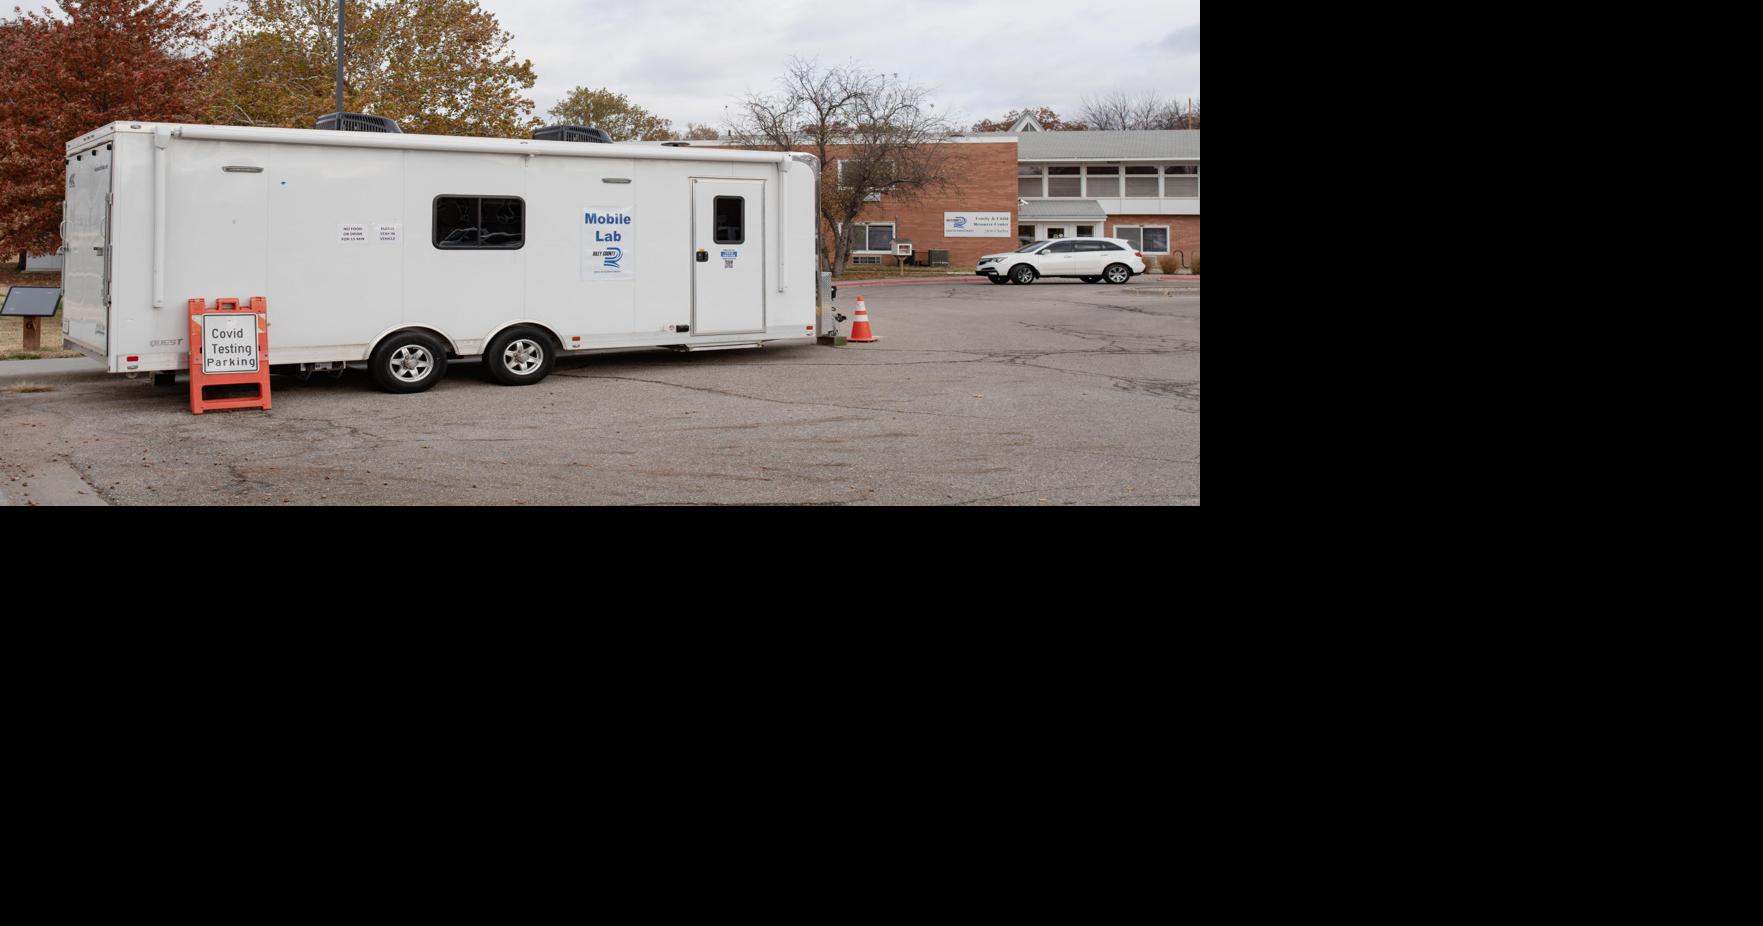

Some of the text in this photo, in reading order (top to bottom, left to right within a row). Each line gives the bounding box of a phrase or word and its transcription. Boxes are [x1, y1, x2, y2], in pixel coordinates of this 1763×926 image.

[584, 212, 631, 224] Mobile
[595, 230, 622, 242] Lab
[211, 328, 244, 339] Covid
[212, 343, 252, 356] Testing
[207, 357, 256, 368] Parking
